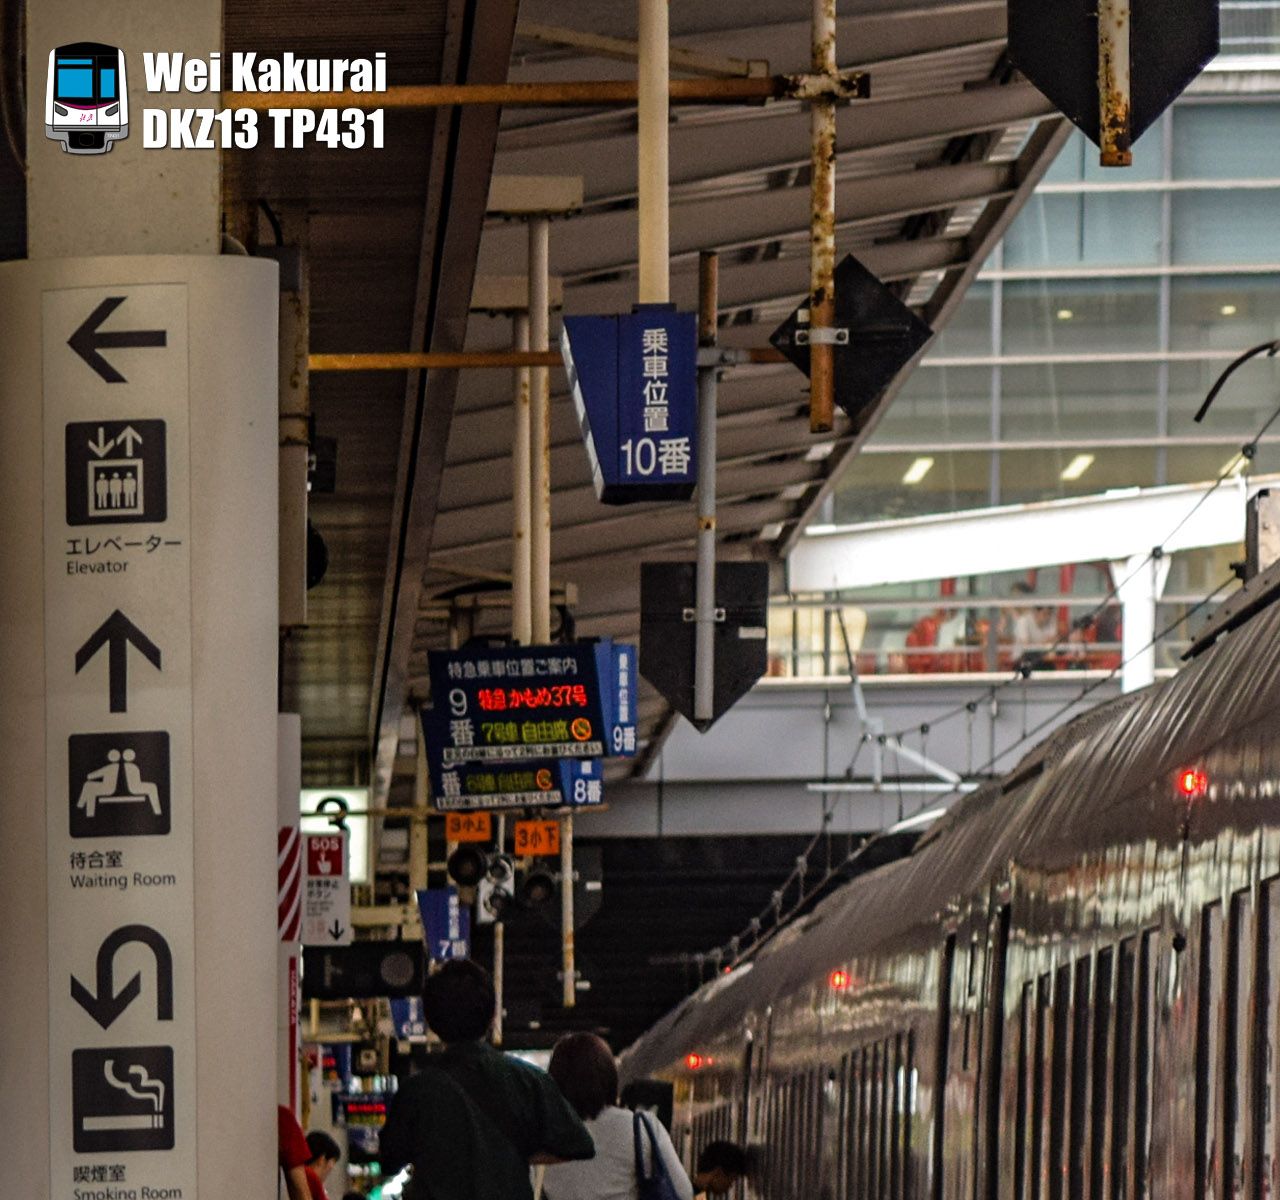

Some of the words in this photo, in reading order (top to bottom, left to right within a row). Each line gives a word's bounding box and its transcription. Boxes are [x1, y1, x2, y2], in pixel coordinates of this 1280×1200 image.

[642, 327, 669, 432] 乗車位置
[620, 436, 691, 476] 10番
[66, 534, 182, 556] エレベーター
[66, 559, 128, 575] Elevator
[310, 837, 339, 851] SOS
[70, 851, 123, 869] 待合室
[70, 873, 129, 890] Waiting
[132, 872, 176, 887] Room
[73, 1164, 126, 1183] 喫煙室
[141, 1186, 183, 1200] Room
